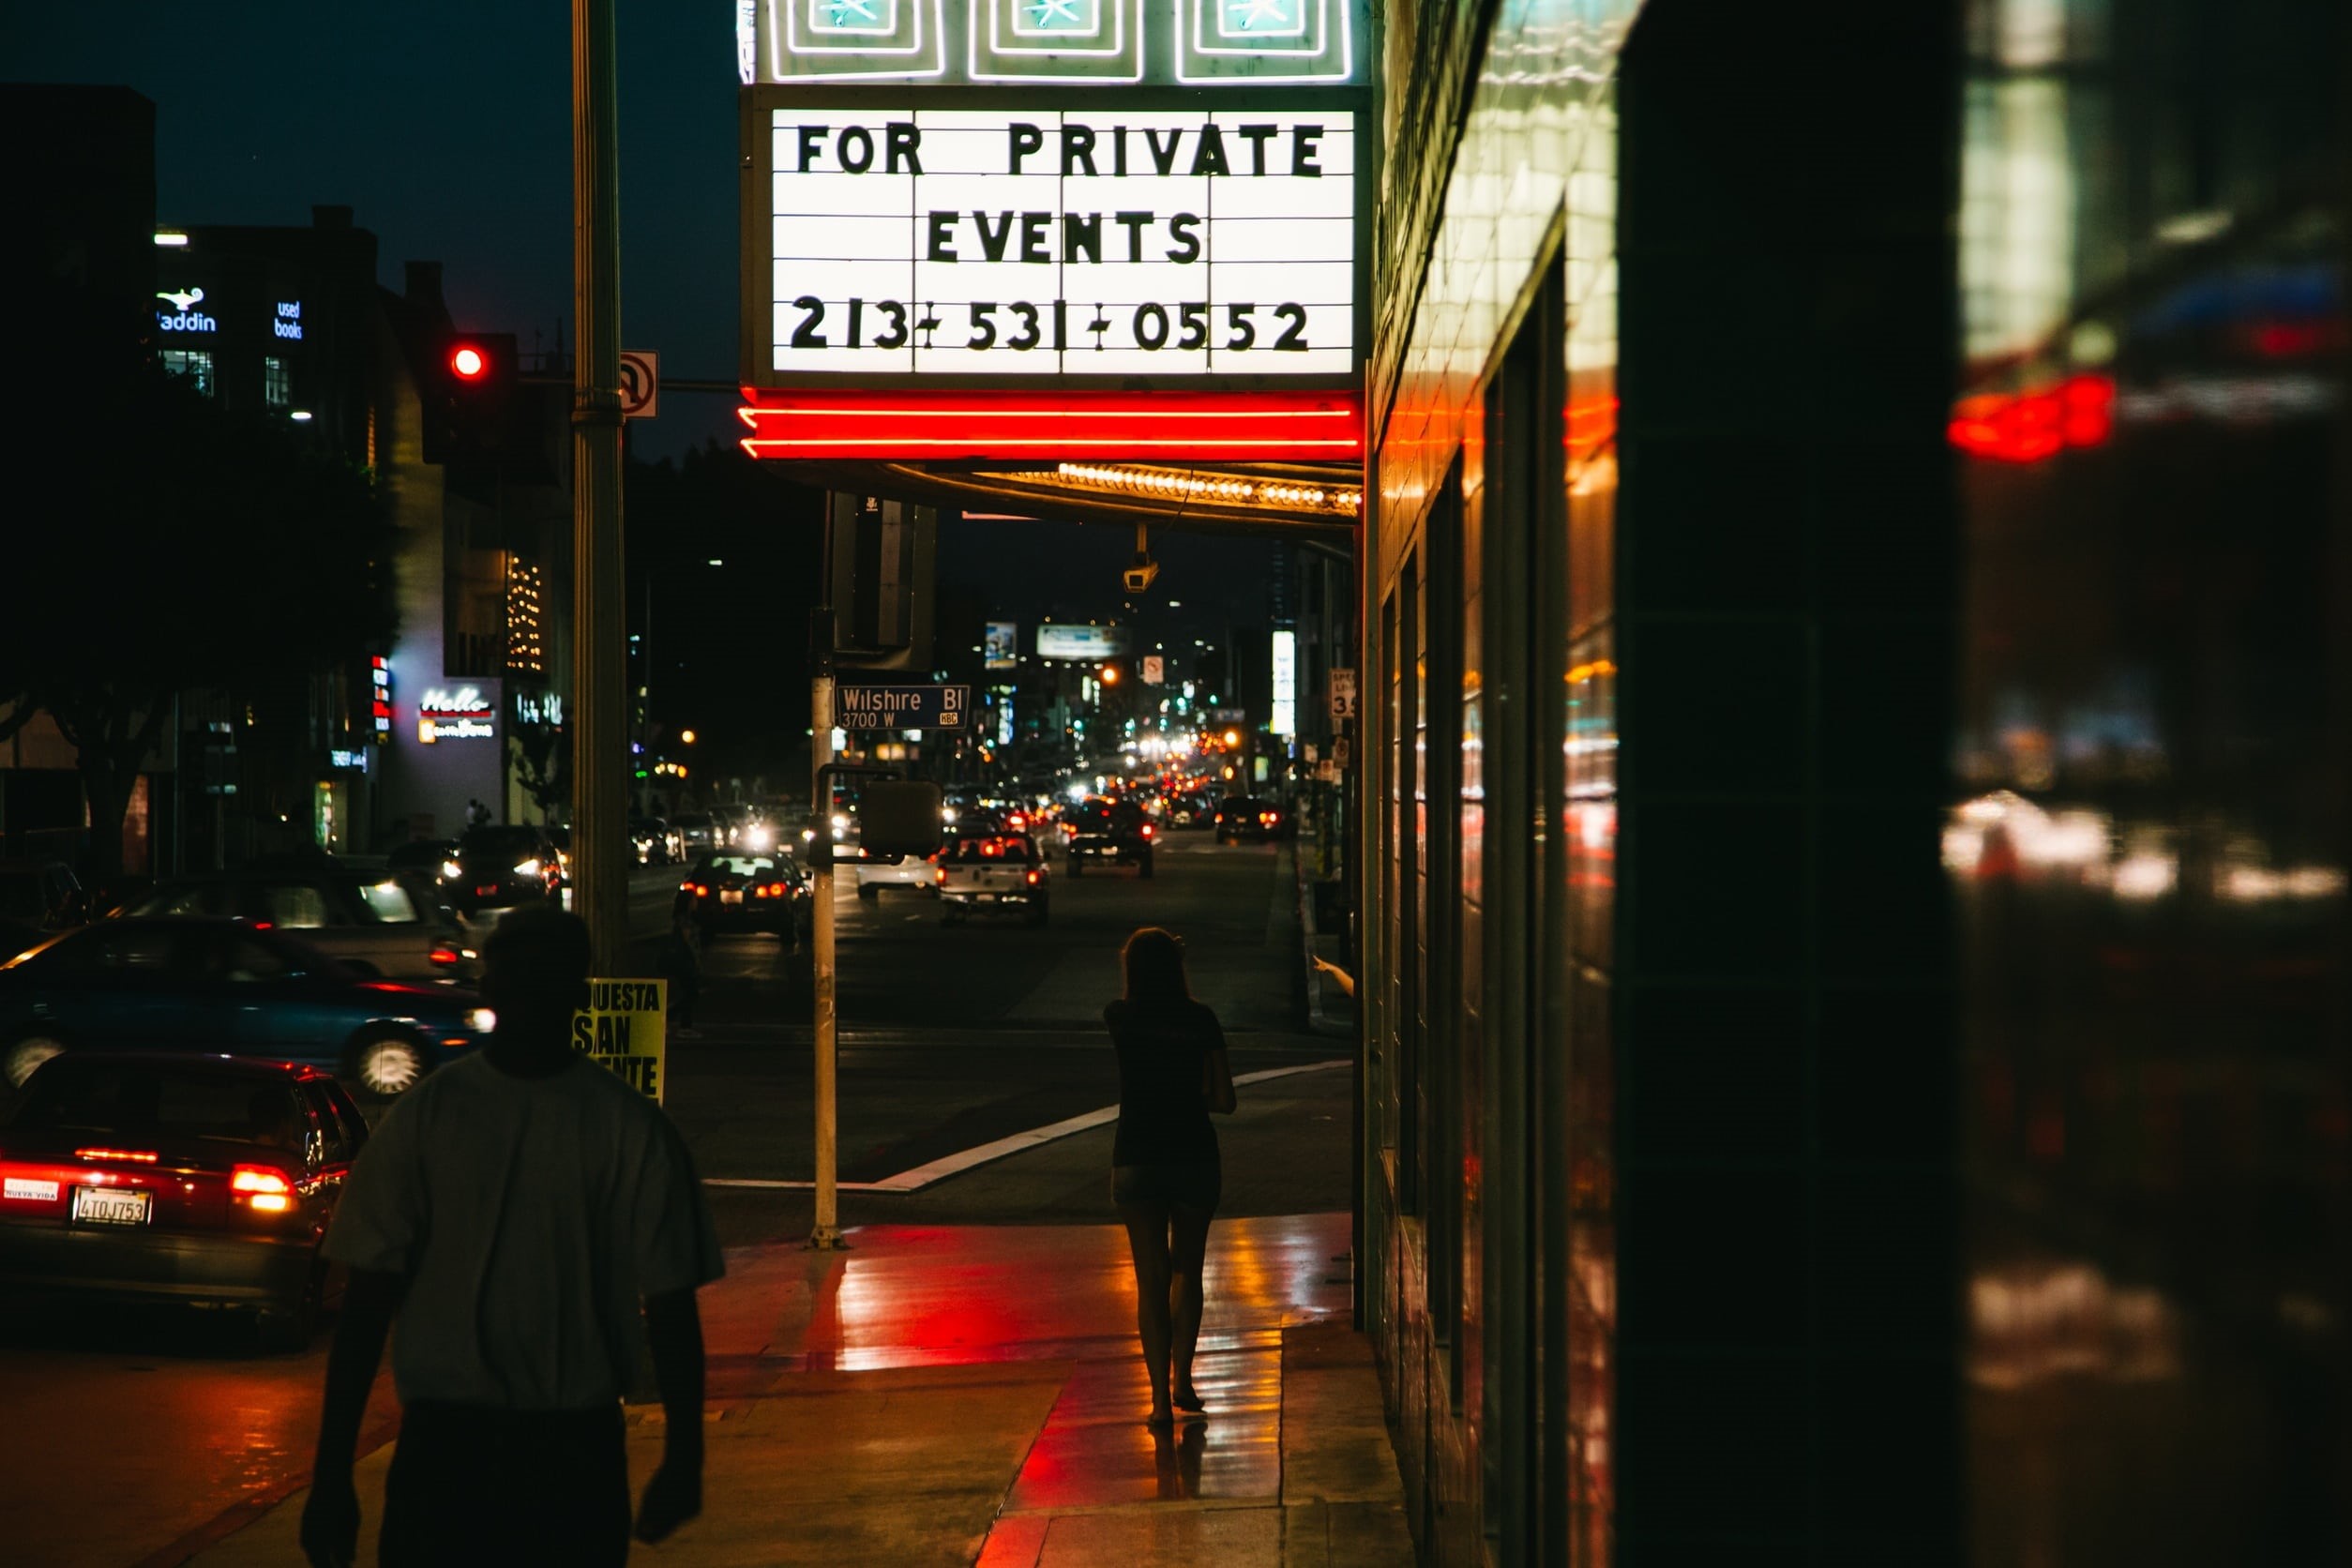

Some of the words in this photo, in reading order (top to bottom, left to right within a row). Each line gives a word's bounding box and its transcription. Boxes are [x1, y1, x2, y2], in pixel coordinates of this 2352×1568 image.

[797, 122, 925, 175] FOR
[1008, 123, 1324, 178] PRIVATE
[927, 209, 1201, 264] EVENTS
[278, 300, 300, 319] used
[274, 318, 302, 339] books
[421, 686, 490, 712] Hello
[844, 688, 922, 711] Wilshire
[943, 687, 962, 711] Bl
[843, 712, 877, 728] 3700
[883, 712, 895, 728] W
[574, 1015, 630, 1056] SAN
[37, 1191, 55, 1200] VIDA
